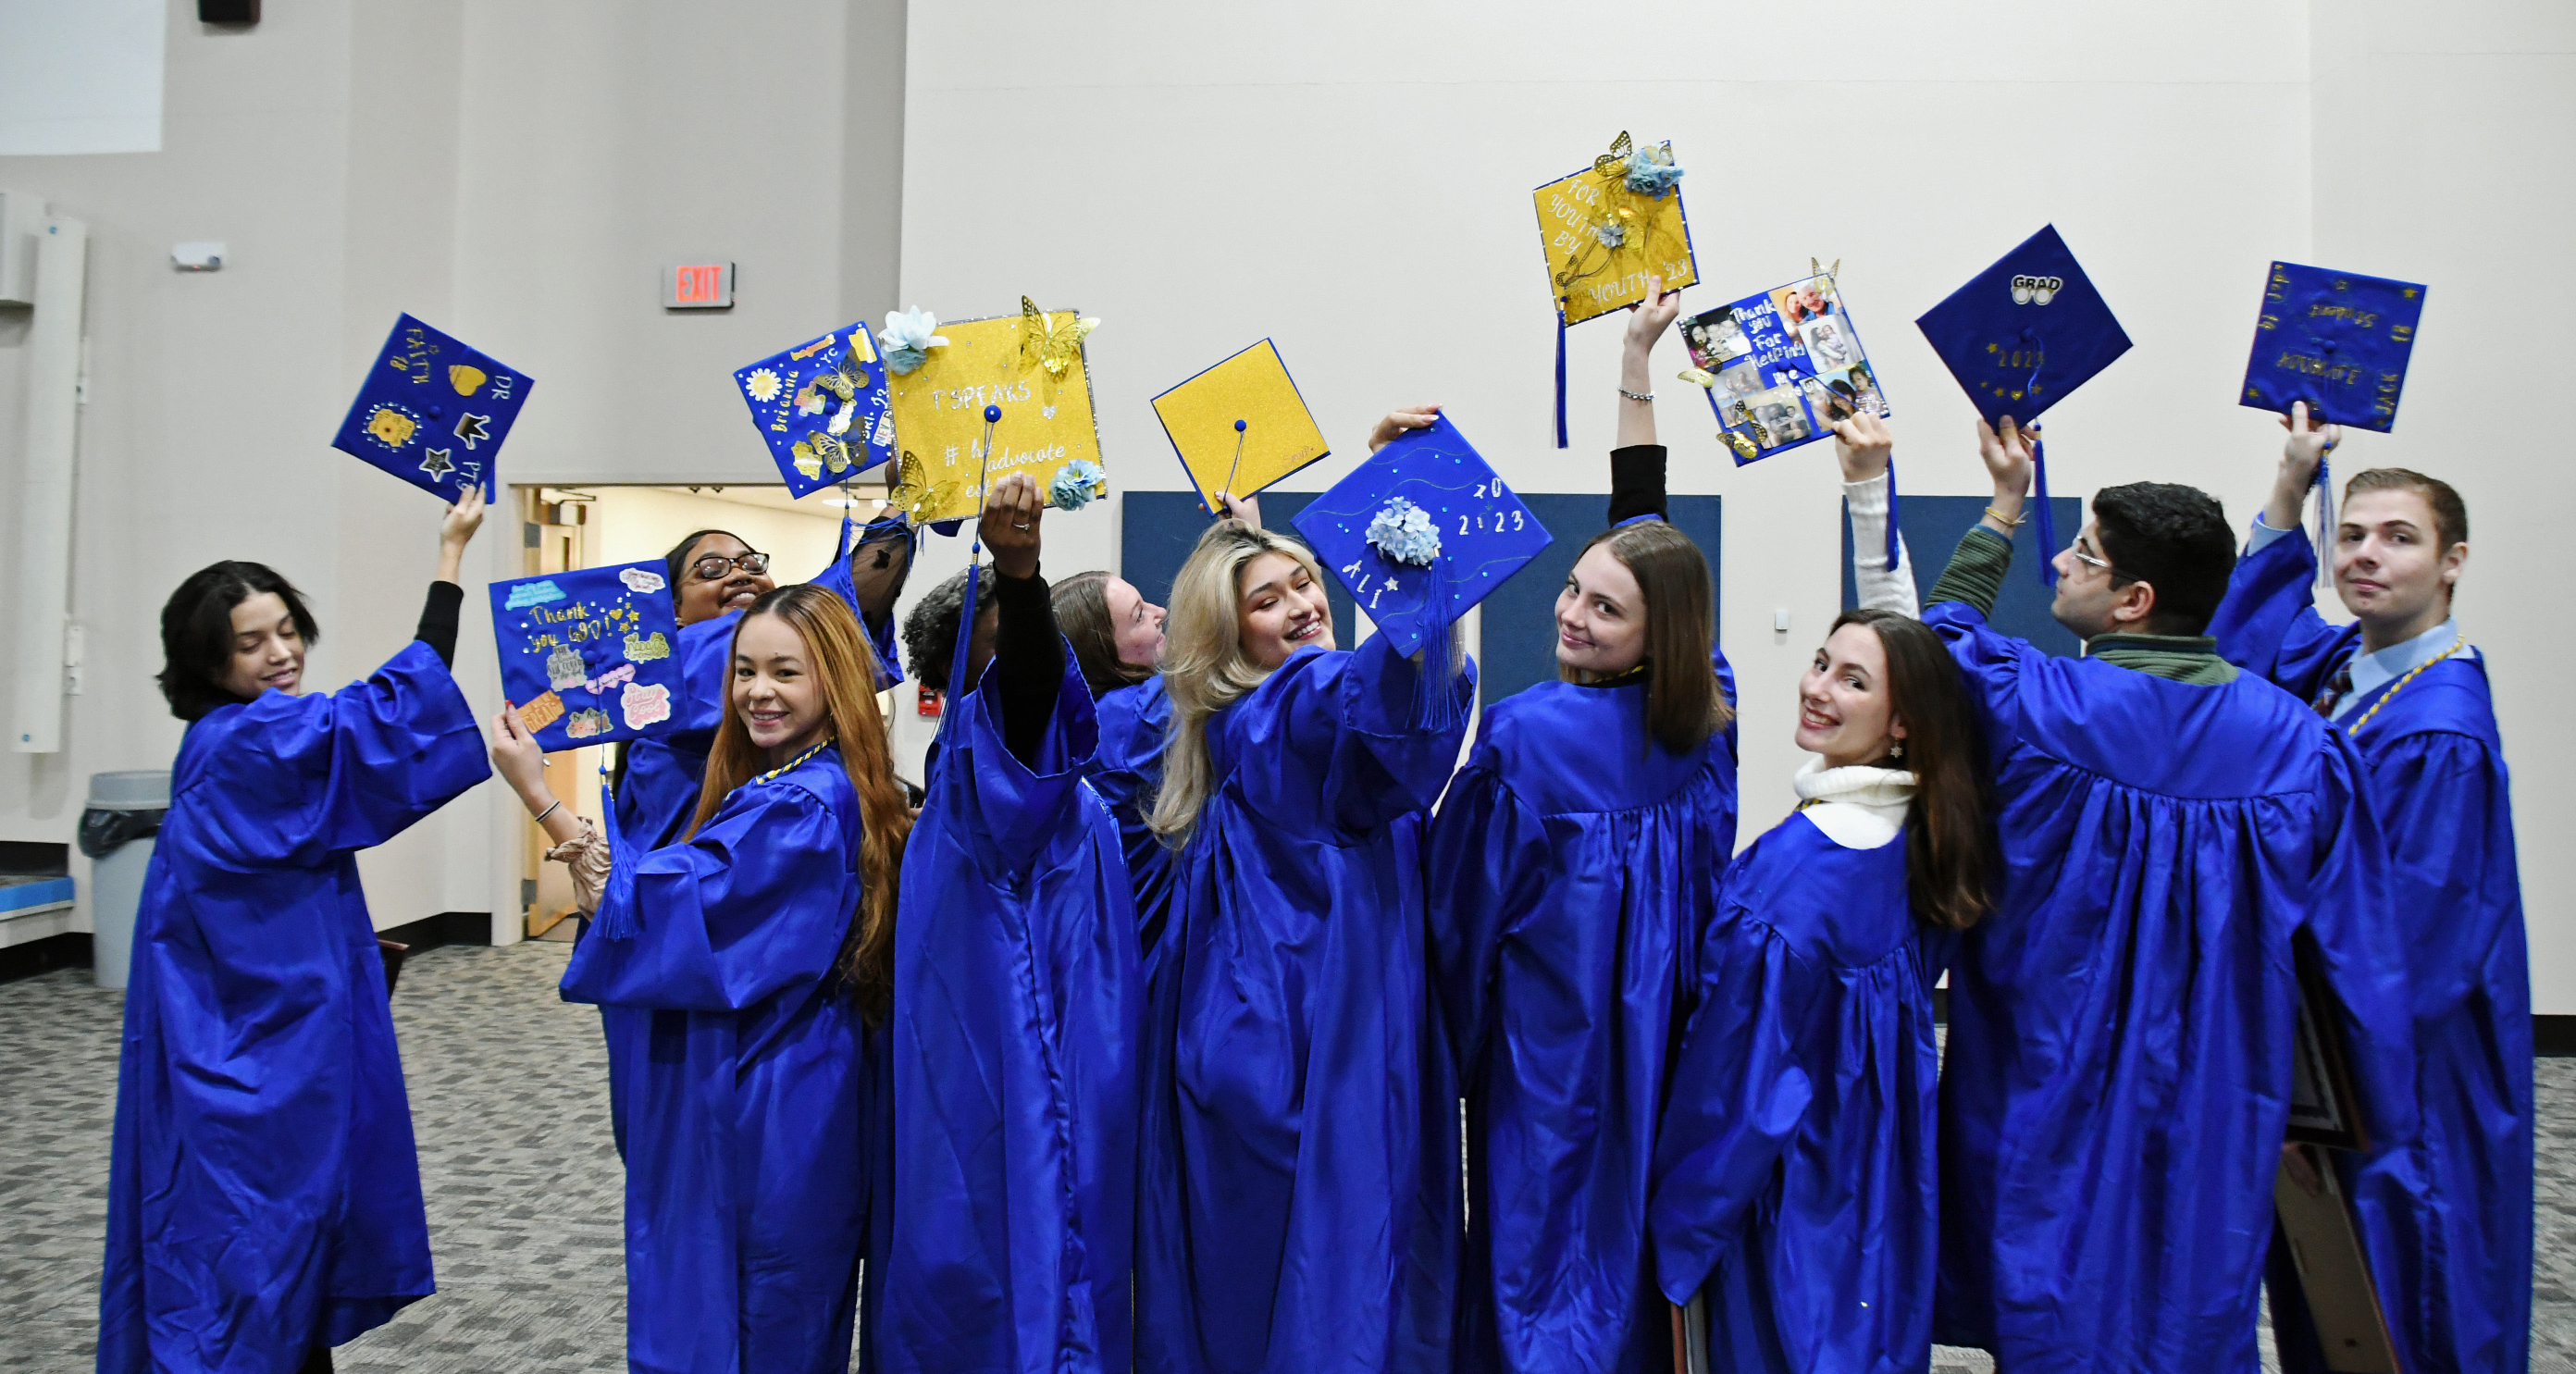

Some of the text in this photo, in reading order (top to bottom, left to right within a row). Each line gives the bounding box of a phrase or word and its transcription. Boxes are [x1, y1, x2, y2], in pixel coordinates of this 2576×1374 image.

[1568, 179, 1599, 206] FOR
[1548, 193, 1603, 238] YOUTH
[1554, 230, 1583, 255] BY
[676, 265, 723, 303] EXIT
[1589, 269, 1651, 306] YOUTH
[2012, 277, 2061, 291] GRAD
[1729, 298, 1777, 325] Thank
[406, 328, 430, 384] FAITH
[820, 347, 838, 364] YC
[491, 375, 513, 400] DR
[931, 379, 1032, 411] T SPEAKS
[2375, 374, 2399, 415] JACK
[770, 370, 800, 433] Brianna
[985, 441, 1067, 473] advocate
[1342, 559, 1382, 609] ALI
[529, 601, 590, 625] Thank
[531, 634, 560, 653] you
[625, 686, 658, 705] Stay
[627, 699, 662, 720] Cool
